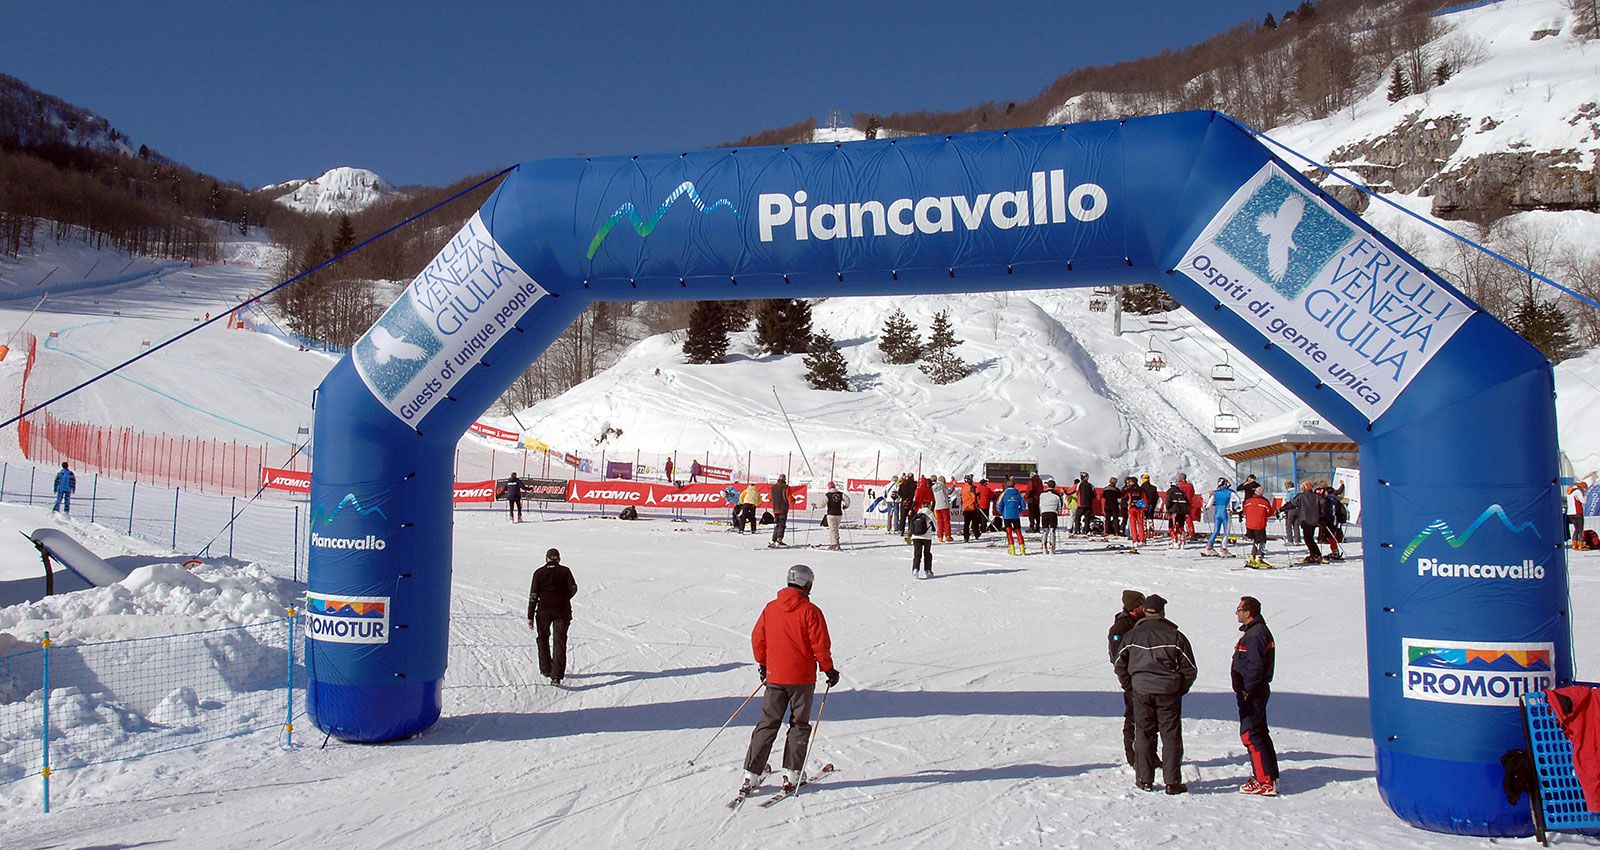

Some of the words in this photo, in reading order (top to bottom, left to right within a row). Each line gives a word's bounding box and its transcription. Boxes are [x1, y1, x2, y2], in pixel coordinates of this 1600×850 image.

[758, 169, 1108, 242] Piancavallo
[413, 223, 477, 295] FRIULI
[417, 238, 496, 314] VENEZIA
[1348, 238, 1453, 321] FRIULI
[436, 260, 517, 336] GIULIA
[1191, 254, 1252, 302] Ospiti
[1247, 297, 1275, 319] di
[1266, 316, 1328, 364] gente
[1327, 362, 1382, 406] unica
[1329, 256, 1435, 353] VENEZIA
[400, 380, 443, 420] Guests
[440, 359, 456, 380] of
[454, 323, 497, 366] unique
[494, 281, 538, 328] people
[1305, 289, 1410, 382] GIULIA
[272, 477, 311, 488] ATOMIC
[453, 489, 494, 498] TOMIC
[583, 489, 641, 501] ATOMIC
[662, 493, 720, 503] ATOMIC
[311, 532, 386, 550] Piancavallo
[1417, 557, 1545, 580] Piancavallo
